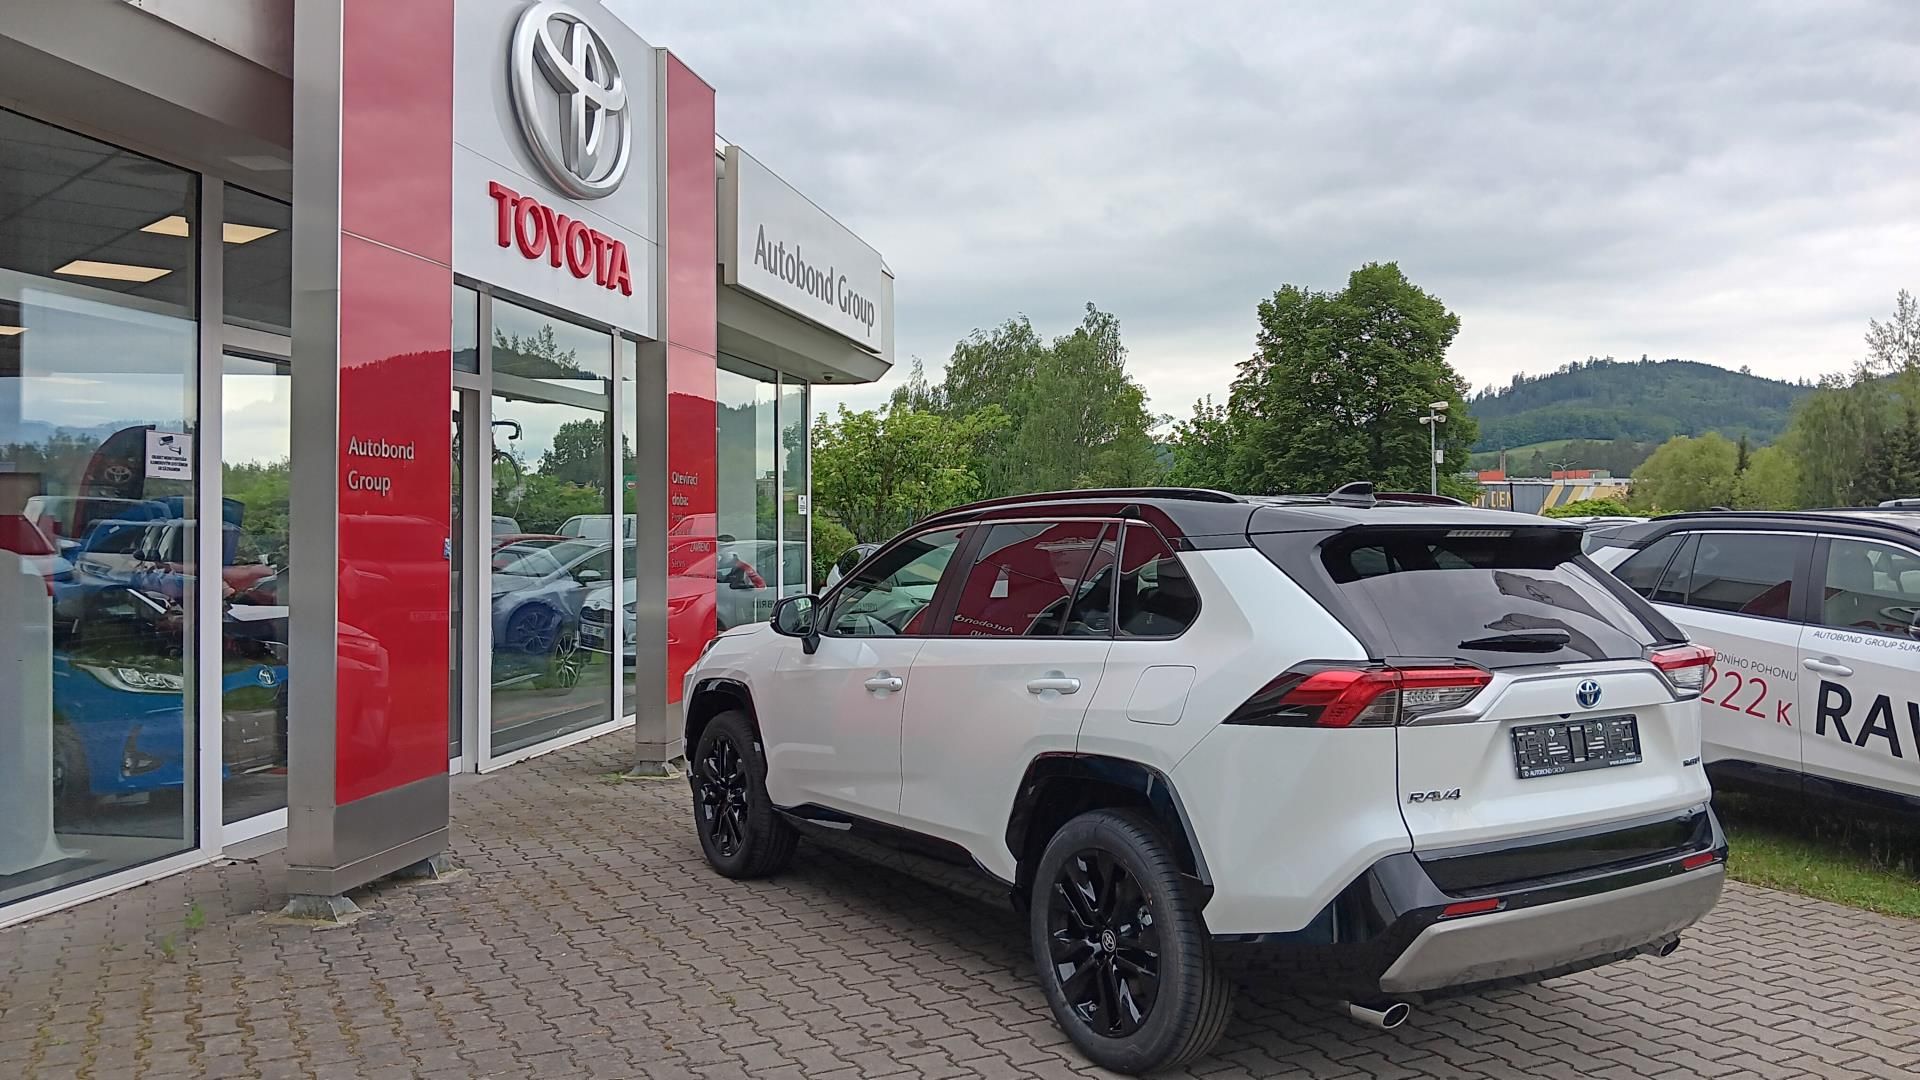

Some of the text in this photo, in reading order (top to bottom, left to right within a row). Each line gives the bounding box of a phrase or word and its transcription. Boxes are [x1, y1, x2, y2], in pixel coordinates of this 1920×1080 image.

[489, 181, 633, 297] TOYOTA
[754, 223, 875, 338] Autobond Group
[348, 435, 415, 460] Autobond
[348, 470, 391, 496] Group
[1814, 630, 1862, 644] AUTOBOND
[1865, 639, 1897, 649] GROUP
[1714, 651, 1797, 682] DNÍHO POHONU
[1777, 700, 1793, 727] K
[1407, 788, 1461, 804] RAV4
